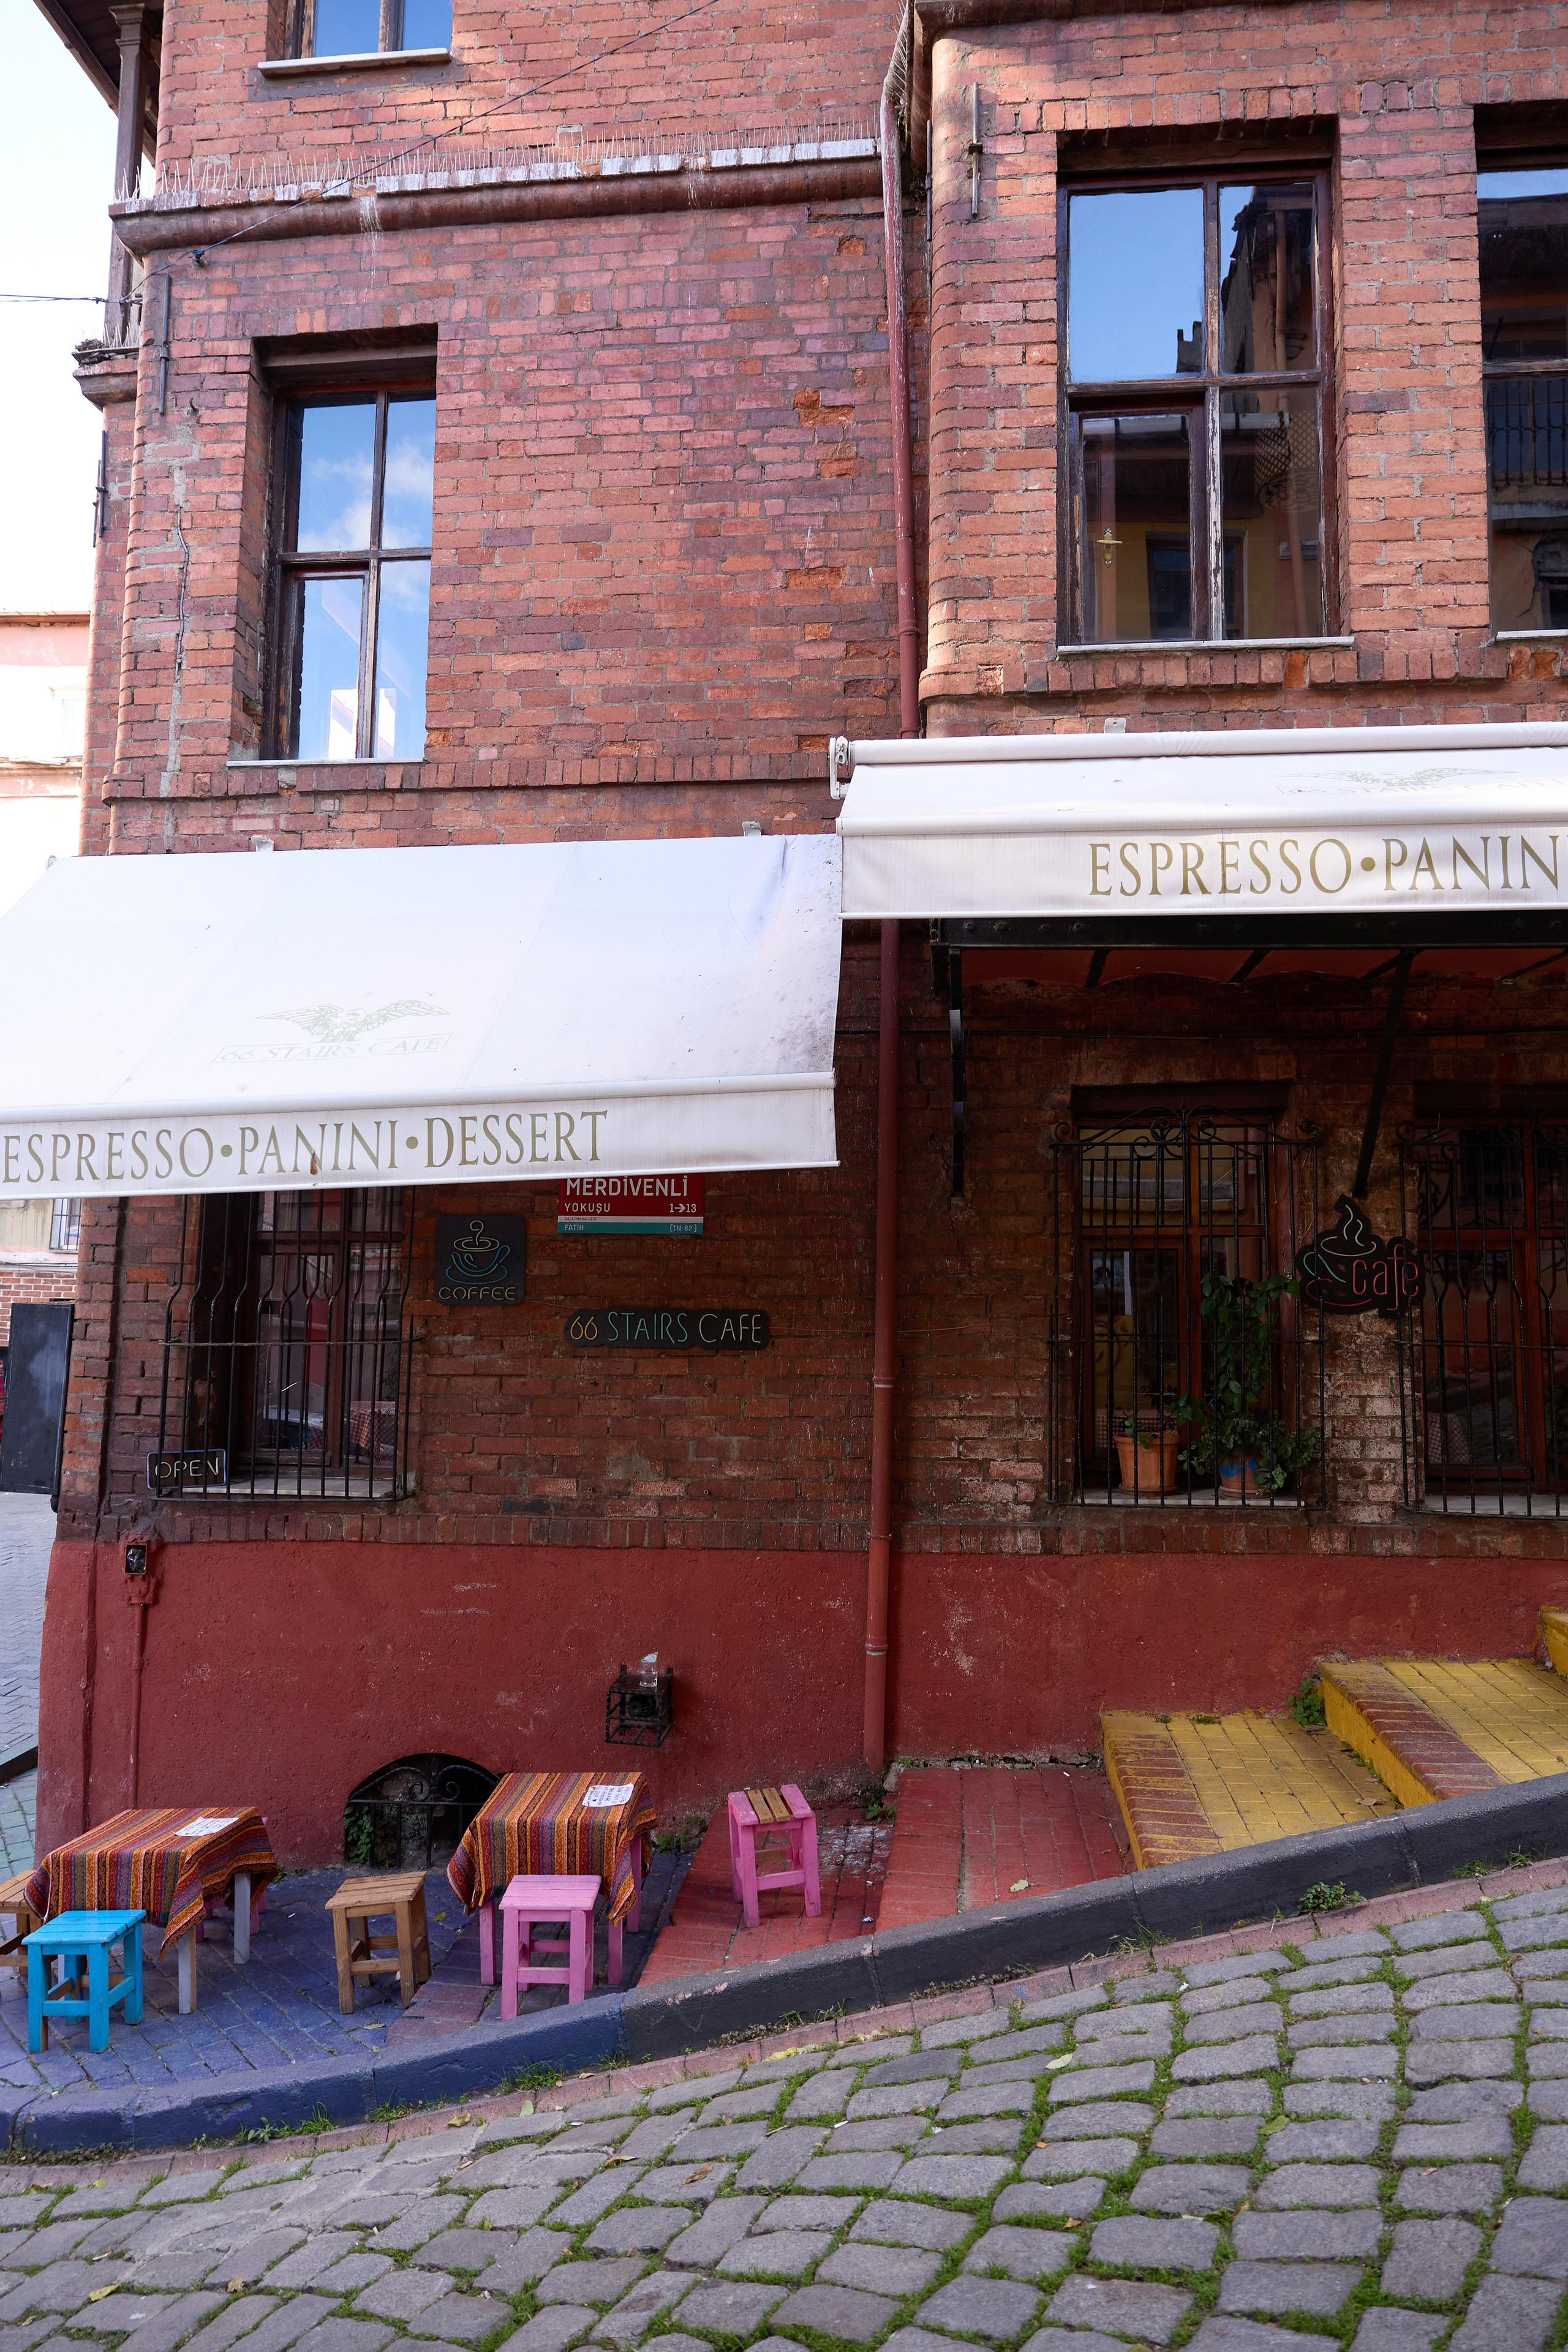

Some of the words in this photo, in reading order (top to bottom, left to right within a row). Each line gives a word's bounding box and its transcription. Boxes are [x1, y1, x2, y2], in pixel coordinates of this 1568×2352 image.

[1338, 785, 1453, 794] STAIRS
[1464, 778, 1555, 791] CAFE
[1090, 839, 1351, 896] ESPRESSO
[1382, 835, 1568, 891] PANIN
[221, 1050, 256, 1061] 66
[263, 1043, 360, 1060] STAIRS
[367, 1037, 444, 1054] CAFE
[2, 1128, 214, 1183] ESPRESSO
[239, 1120, 399, 1175] PANINI
[424, 1110, 608, 1168] DESSERT
[566, 1175, 688, 1196] MERDİVENLİ
[564, 1202, 611, 1214] YOKUŞU
[1352, 1244, 1419, 1311] cafe
[439, 1286, 517, 1301] COFFEE
[570, 1316, 598, 1341] 66
[608, 1311, 688, 1344] STAIRS
[698, 1314, 761, 1343] CAFE
[155, 1457, 219, 1479] OPEN
